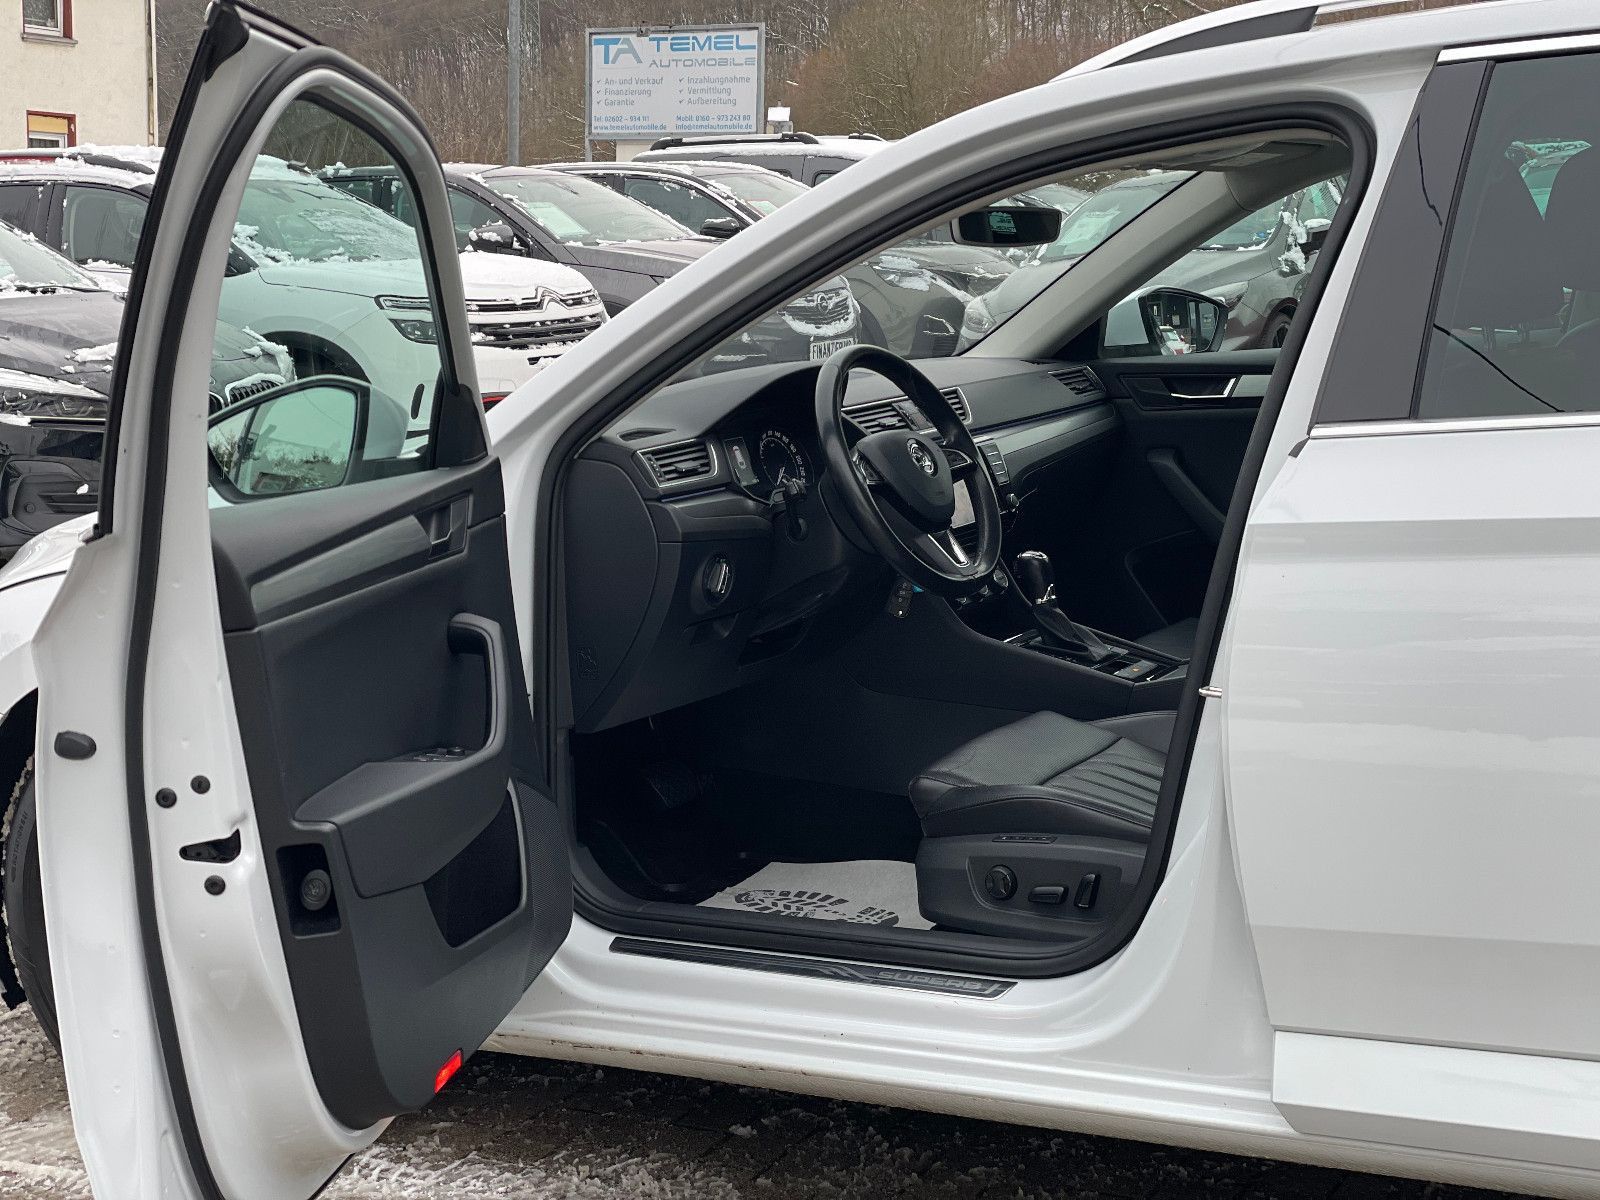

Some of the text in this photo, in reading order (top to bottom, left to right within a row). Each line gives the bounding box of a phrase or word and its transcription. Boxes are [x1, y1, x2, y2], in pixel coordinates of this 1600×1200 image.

[649, 34, 757, 52] TEMEL
[619, 77, 633, 85] und
[635, 77, 664, 85] Verkauf
[687, 75, 751, 85] Inzahlungnahme
[604, 88, 652, 97] Finanzierung
[687, 86, 732, 96] Vermittlung
[604, 98, 635, 106] Garantie
[687, 97, 737, 106] Aufbereitung
[593, 123, 667, 131] www.temelautomobile.de
[675, 123, 753, 131] info@temelautomobile.de
[878, 971, 982, 989] SUPERB
